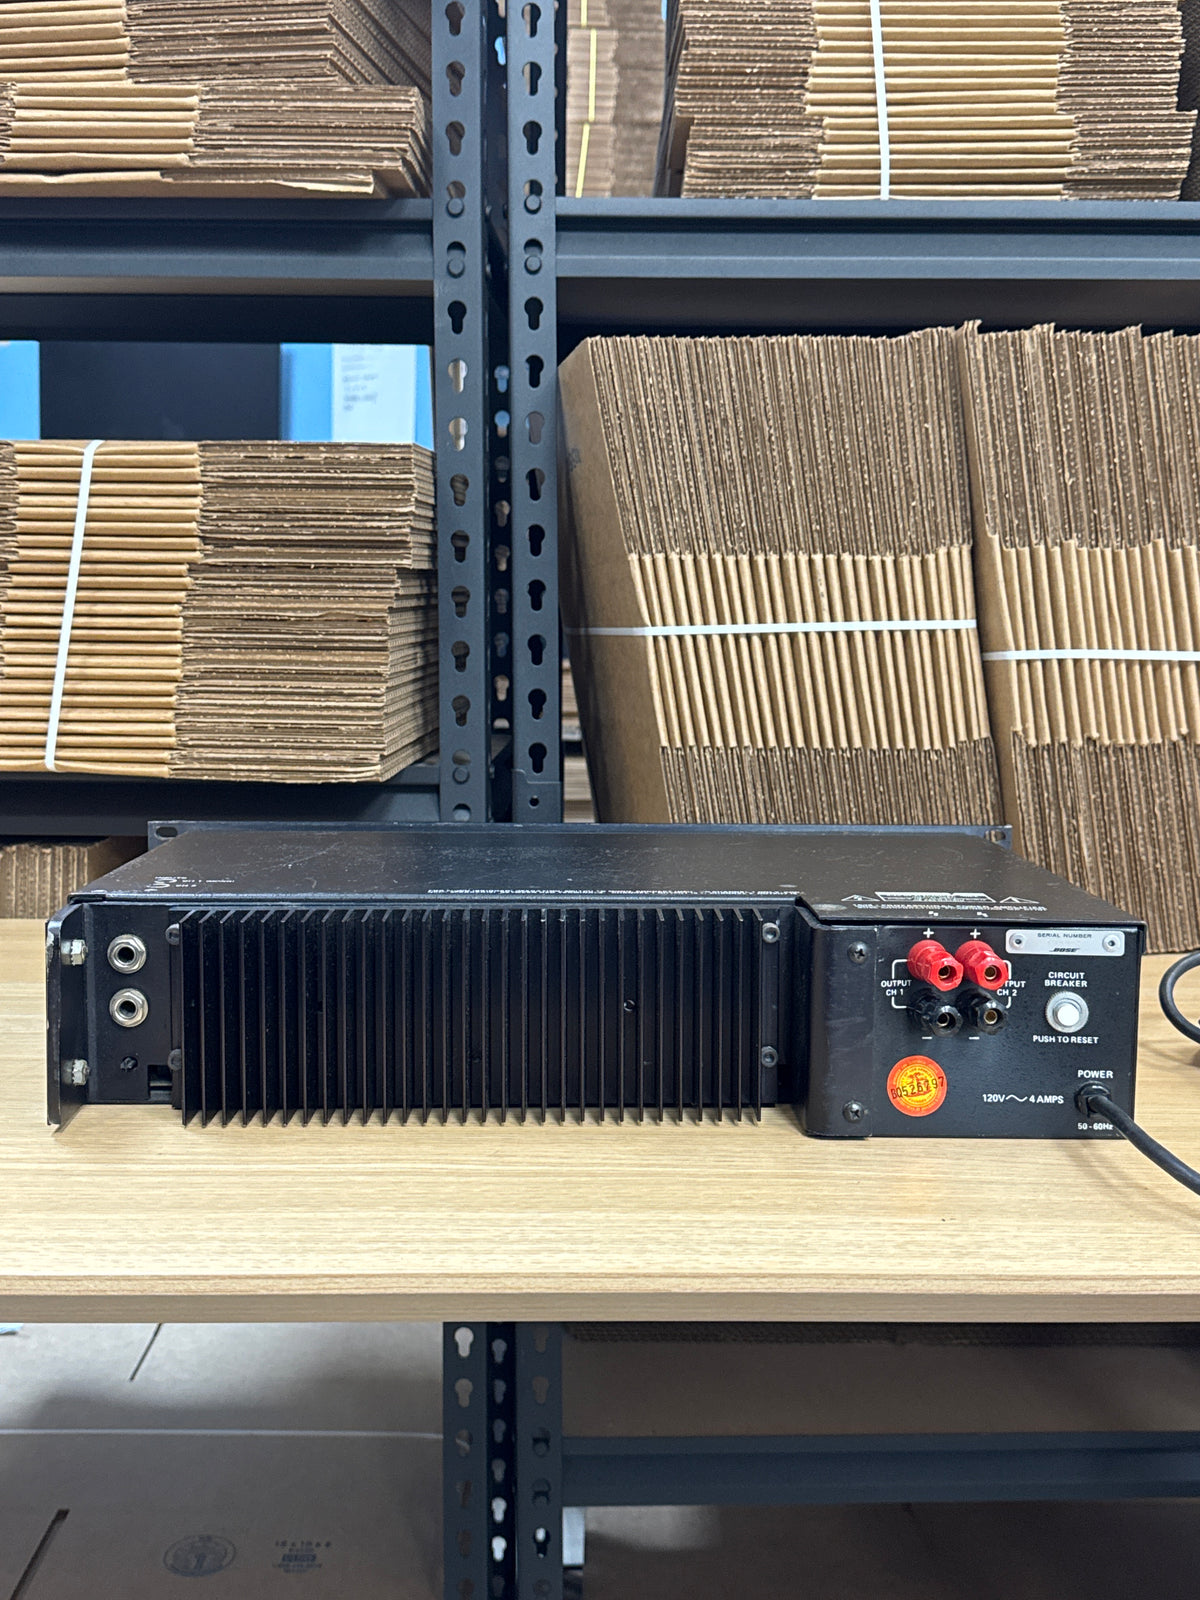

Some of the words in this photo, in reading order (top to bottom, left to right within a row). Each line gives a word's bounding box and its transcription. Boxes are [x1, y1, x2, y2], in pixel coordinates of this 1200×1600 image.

[1048, 971, 1085, 980] CIRCUIT
[880, 979, 912, 988] OUTPUT
[1003, 980, 1026, 988] TPUT
[1044, 979, 1088, 988] BREAKER
[885, 988, 897, 996] CH
[996, 988, 1009, 996] CH
[1011, 989, 1017, 997] 2
[1032, 1034, 1056, 1043] PUSH
[1057, 1035, 1069, 1043] TO
[1070, 1035, 1099, 1044] RESET
[1077, 1069, 1114, 1079] POWER
[1036, 1094, 1064, 1104] AMPS
